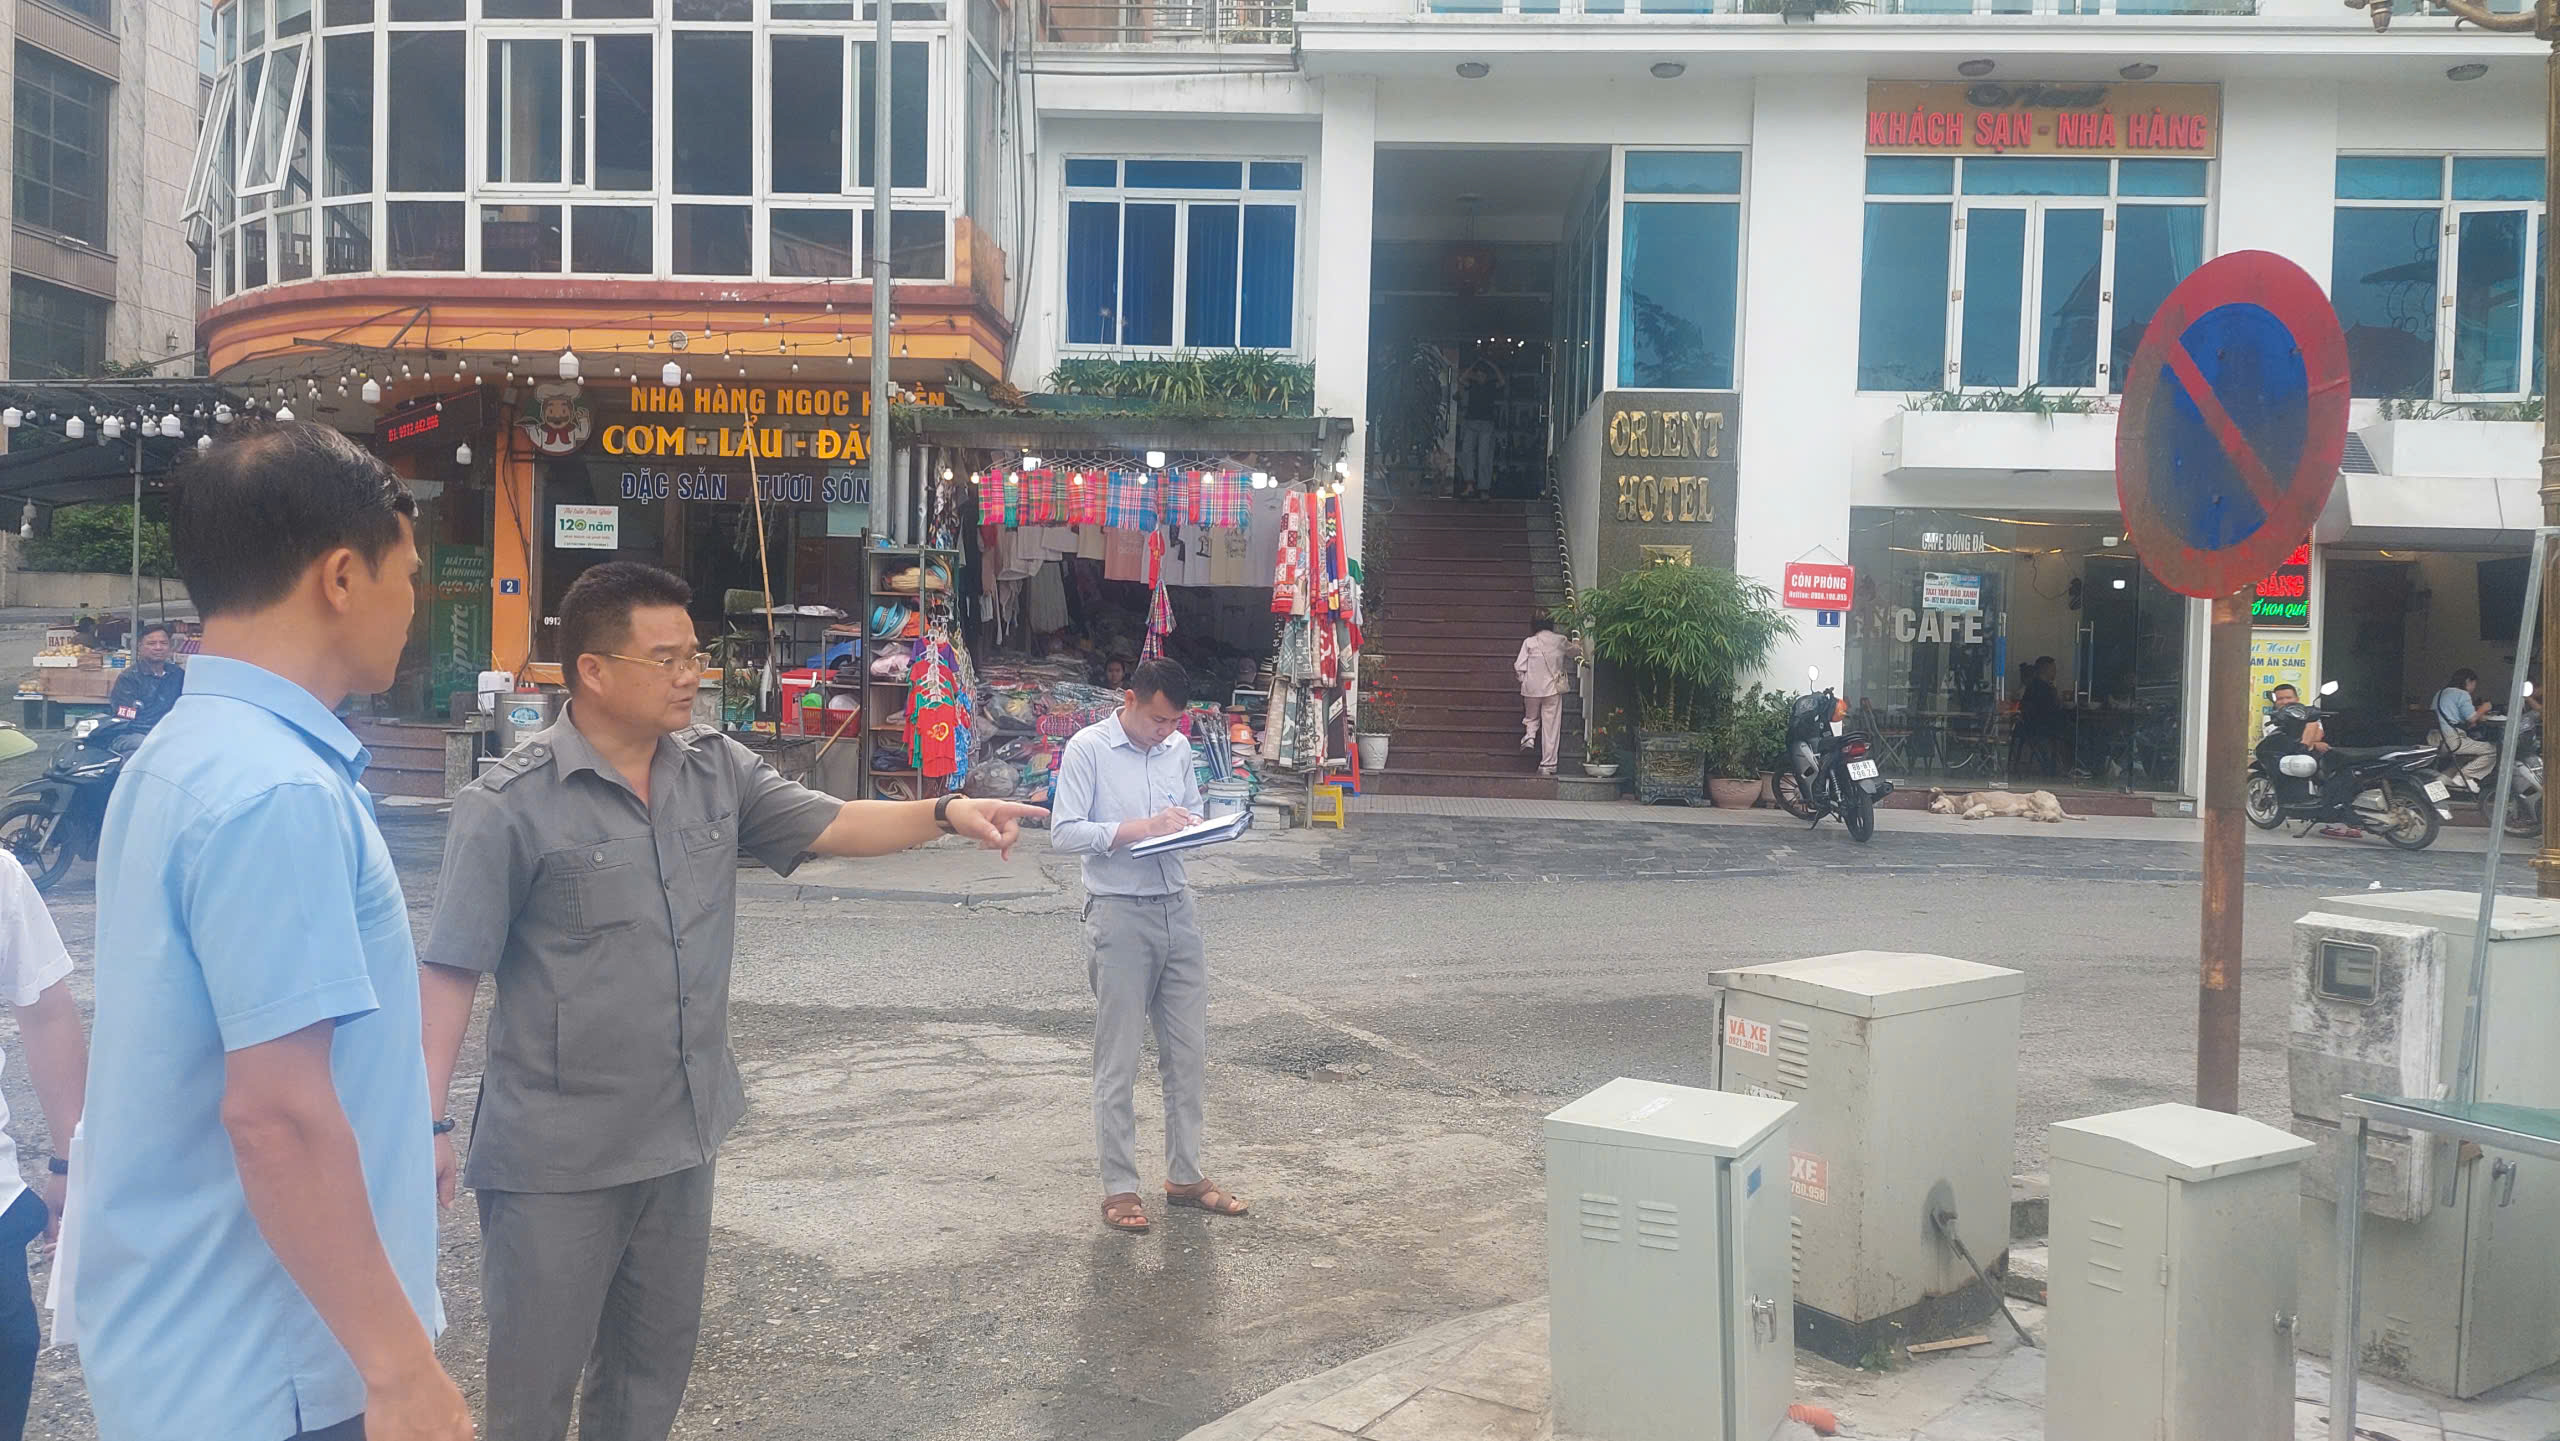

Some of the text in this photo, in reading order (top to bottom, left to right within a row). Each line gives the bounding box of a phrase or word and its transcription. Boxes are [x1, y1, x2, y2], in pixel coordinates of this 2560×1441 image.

[1869, 106, 1964, 146] KHÁCH
[1975, 113, 2034, 153] SẠN
[2058, 107, 2117, 147] NHÀ
[2128, 106, 2208, 148] HÀNG
[695, 384, 765, 414] HÀNG
[602, 424, 686, 456] CƠM
[718, 415, 783, 458] LẨU
[815, 422, 871, 466] ĐẶ
[1609, 410, 1724, 458] ORIENT
[621, 467, 670, 504] ĐẶC
[677, 465, 727, 501] SẢN
[756, 472, 813, 502] TƯƠI
[1616, 475, 1715, 523] HOTEL
[588, 521, 615, 532] năm
[1922, 532, 1944, 551] CAFE
[1946, 531, 1971, 552] BÓNG
[506, 580, 514, 593] 2
[1791, 571, 1847, 590] CÒN PHÒNG
[2256, 570, 2305, 597] SÁNG
[1826, 612, 1832, 625] 1
[2261, 602, 2284, 616] HOA
[1895, 608, 1984, 644] CAFE
[1729, 1018, 1768, 1043] VÁ XE
[1790, 1156, 1817, 1183] XE
